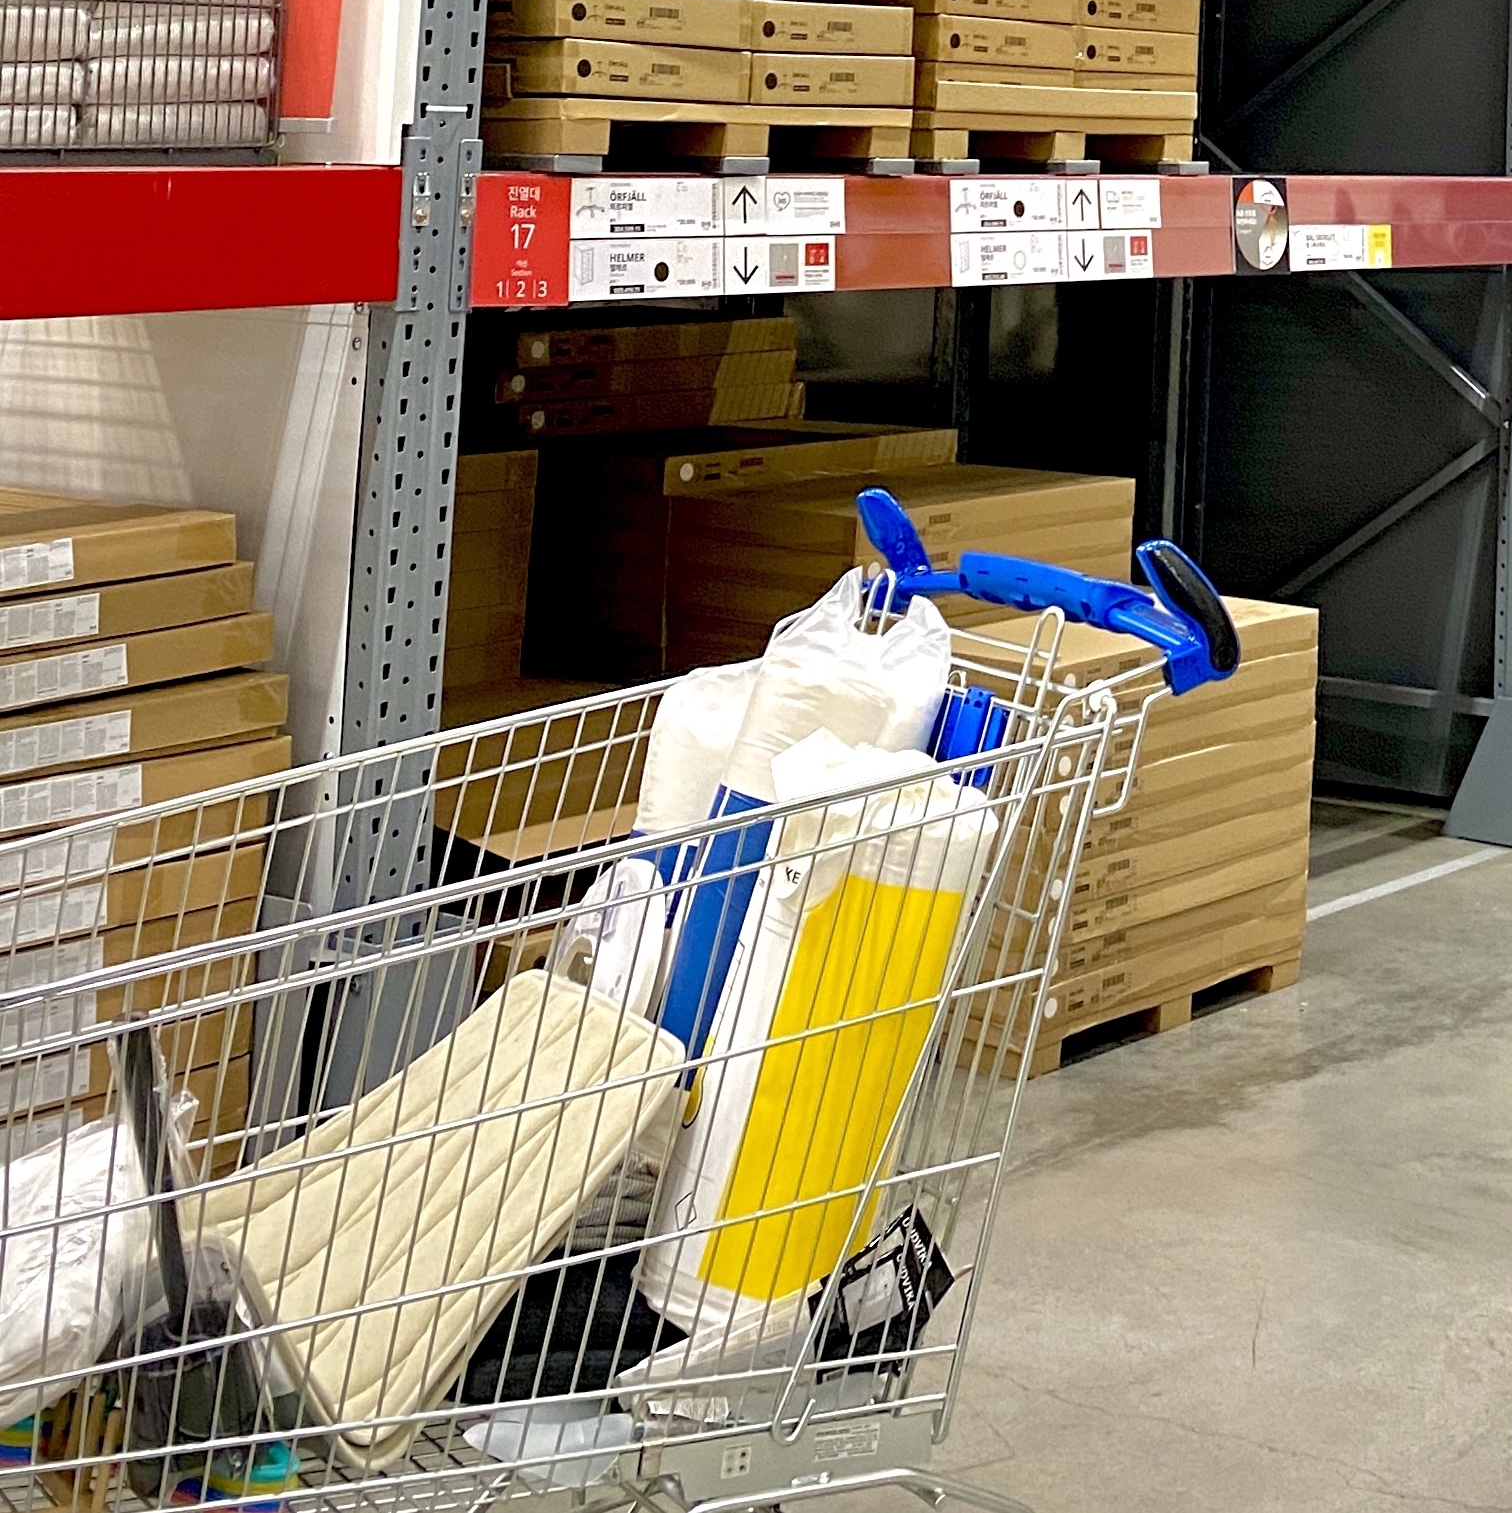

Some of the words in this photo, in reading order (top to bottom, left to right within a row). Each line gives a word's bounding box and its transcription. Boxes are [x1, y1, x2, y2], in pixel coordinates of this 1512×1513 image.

[508, 186, 541, 201] 진열대
[609, 190, 647, 202] ÖRFJÄLL
[510, 205, 537, 218] Rack
[510, 224, 536, 249] 17
[609, 253, 645, 263] HELMER
[496, 280, 503, 298] 1
[516, 280, 526, 298] 2
[537, 280, 548, 298] 3
